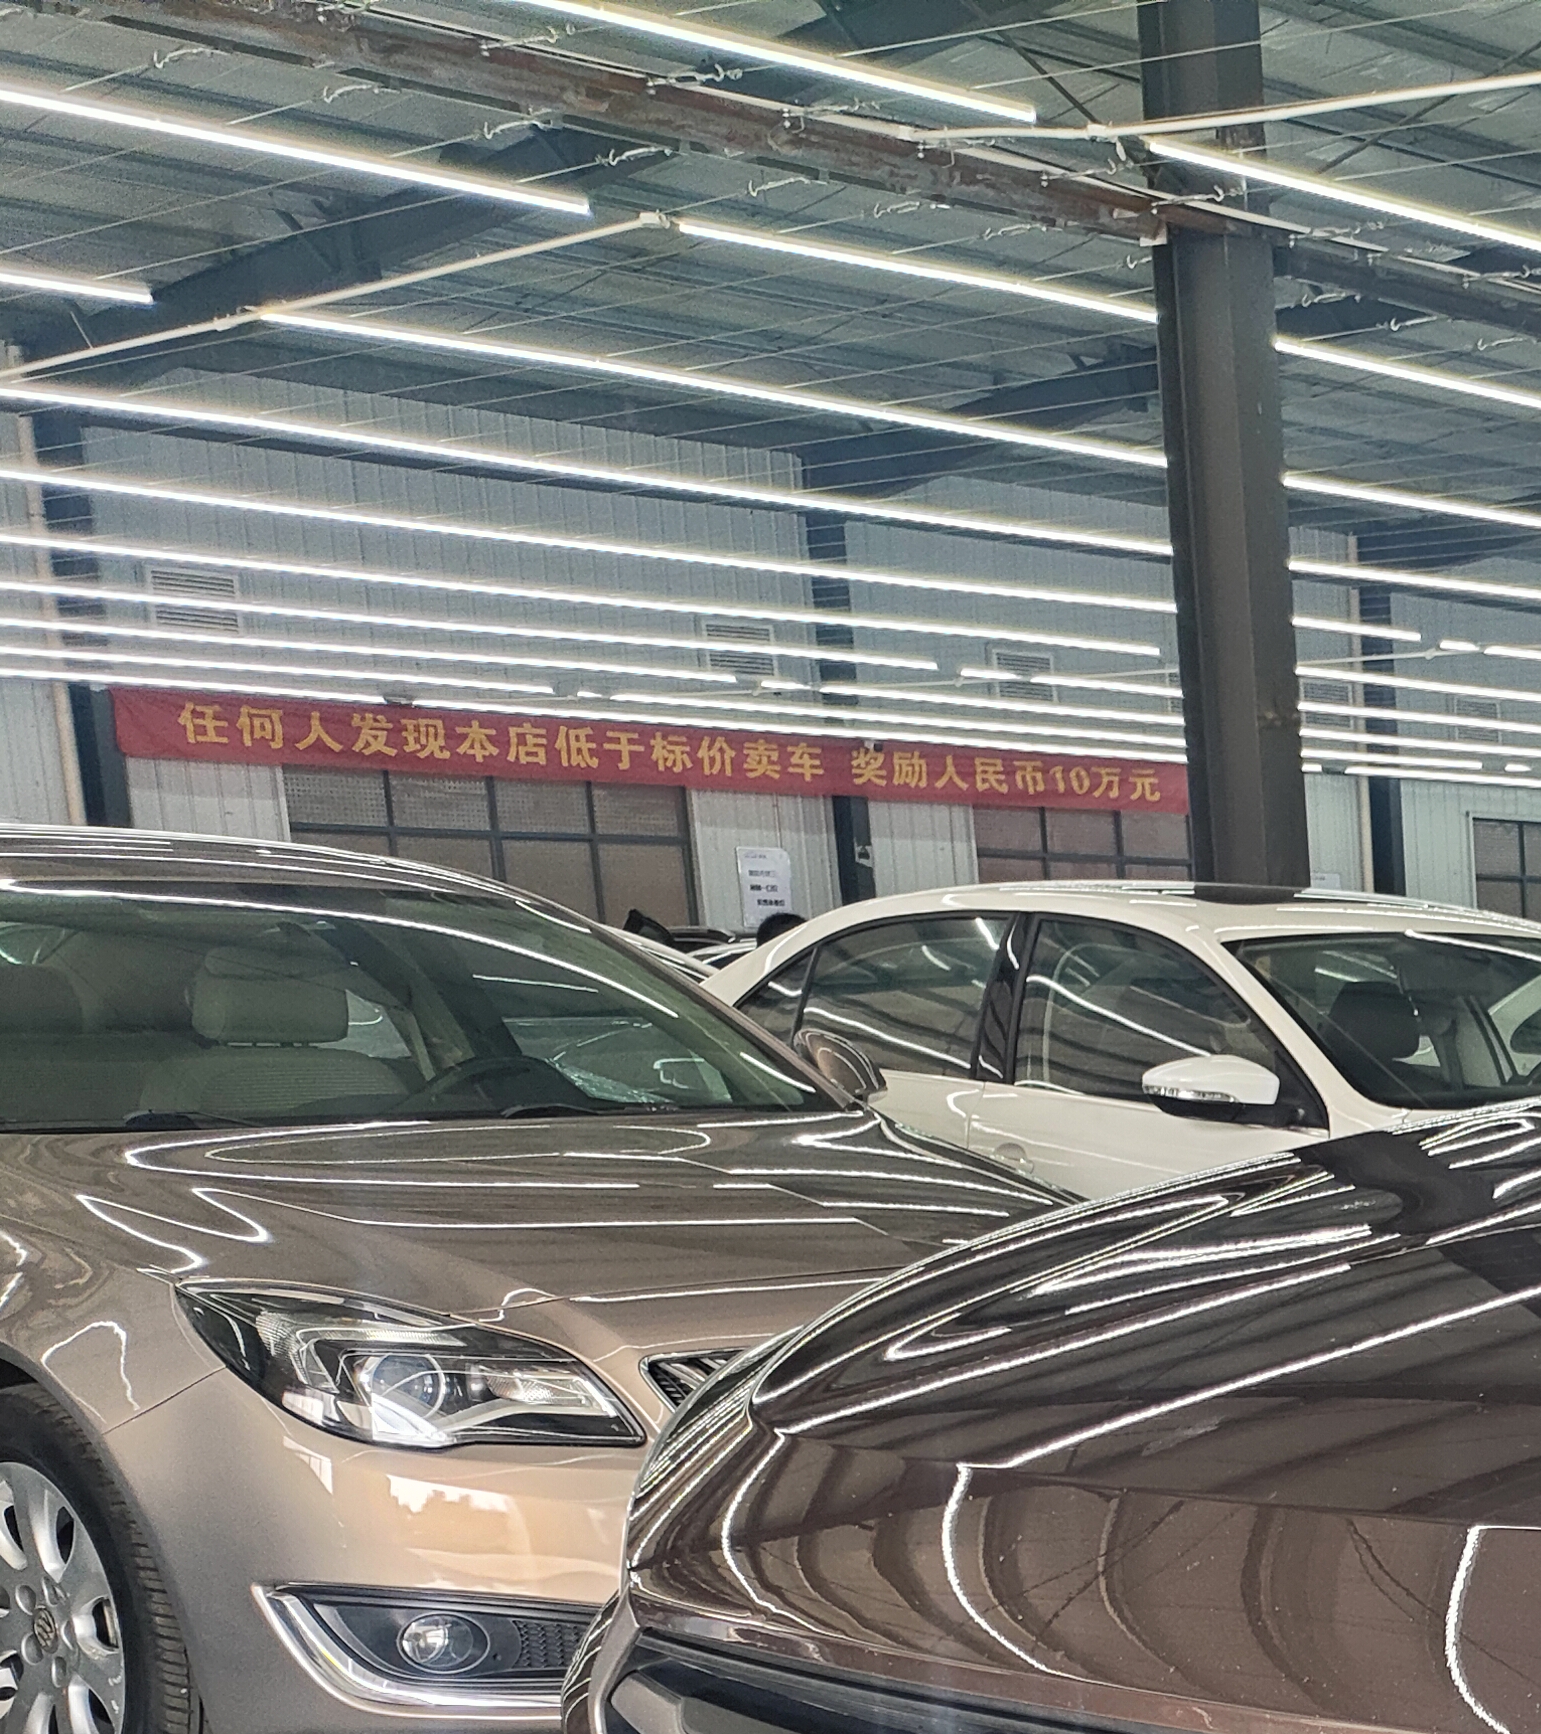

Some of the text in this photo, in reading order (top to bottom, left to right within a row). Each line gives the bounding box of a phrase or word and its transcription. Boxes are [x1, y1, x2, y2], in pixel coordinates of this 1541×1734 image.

[177, 700, 1162, 803] 任何人发现本店低于标价卖车 奖励人民币10万元
